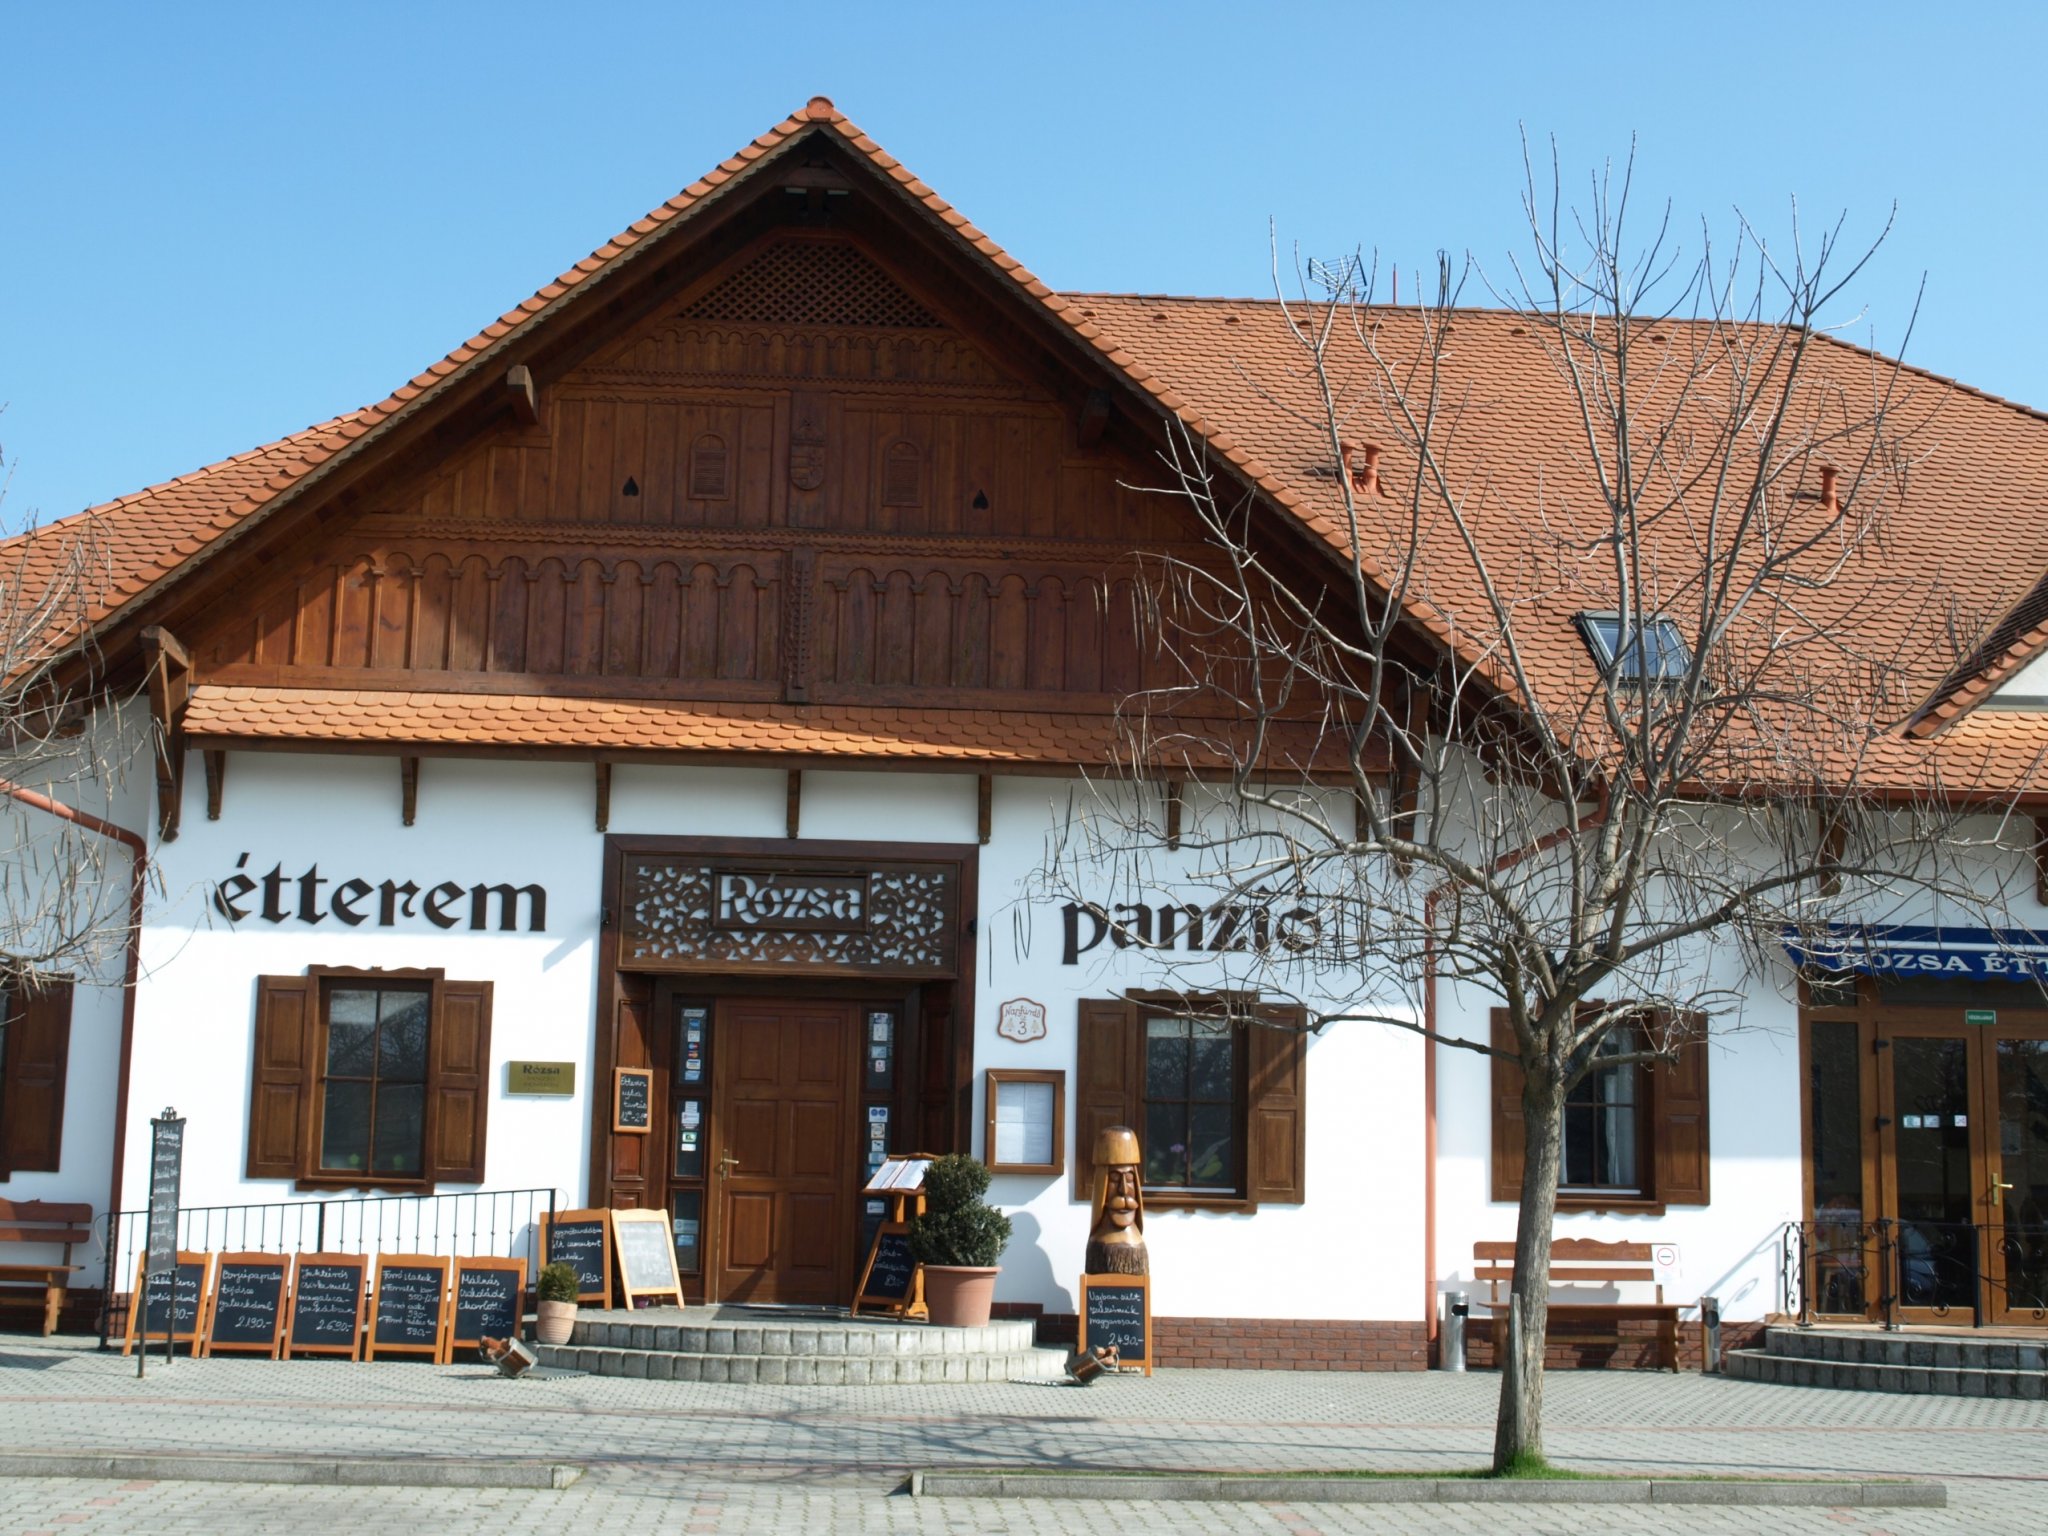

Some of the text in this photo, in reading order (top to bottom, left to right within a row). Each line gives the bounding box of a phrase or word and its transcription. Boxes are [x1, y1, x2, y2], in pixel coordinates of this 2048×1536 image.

[214, 853, 547, 932] étterem
[720, 872, 863, 924] Rózsa
[1061, 884, 1321, 965] panzió
[1017, 1021, 1028, 1035] 3
[523, 1064, 560, 1075] Rózsa
[480, 1313, 513, 1328] 990.-
